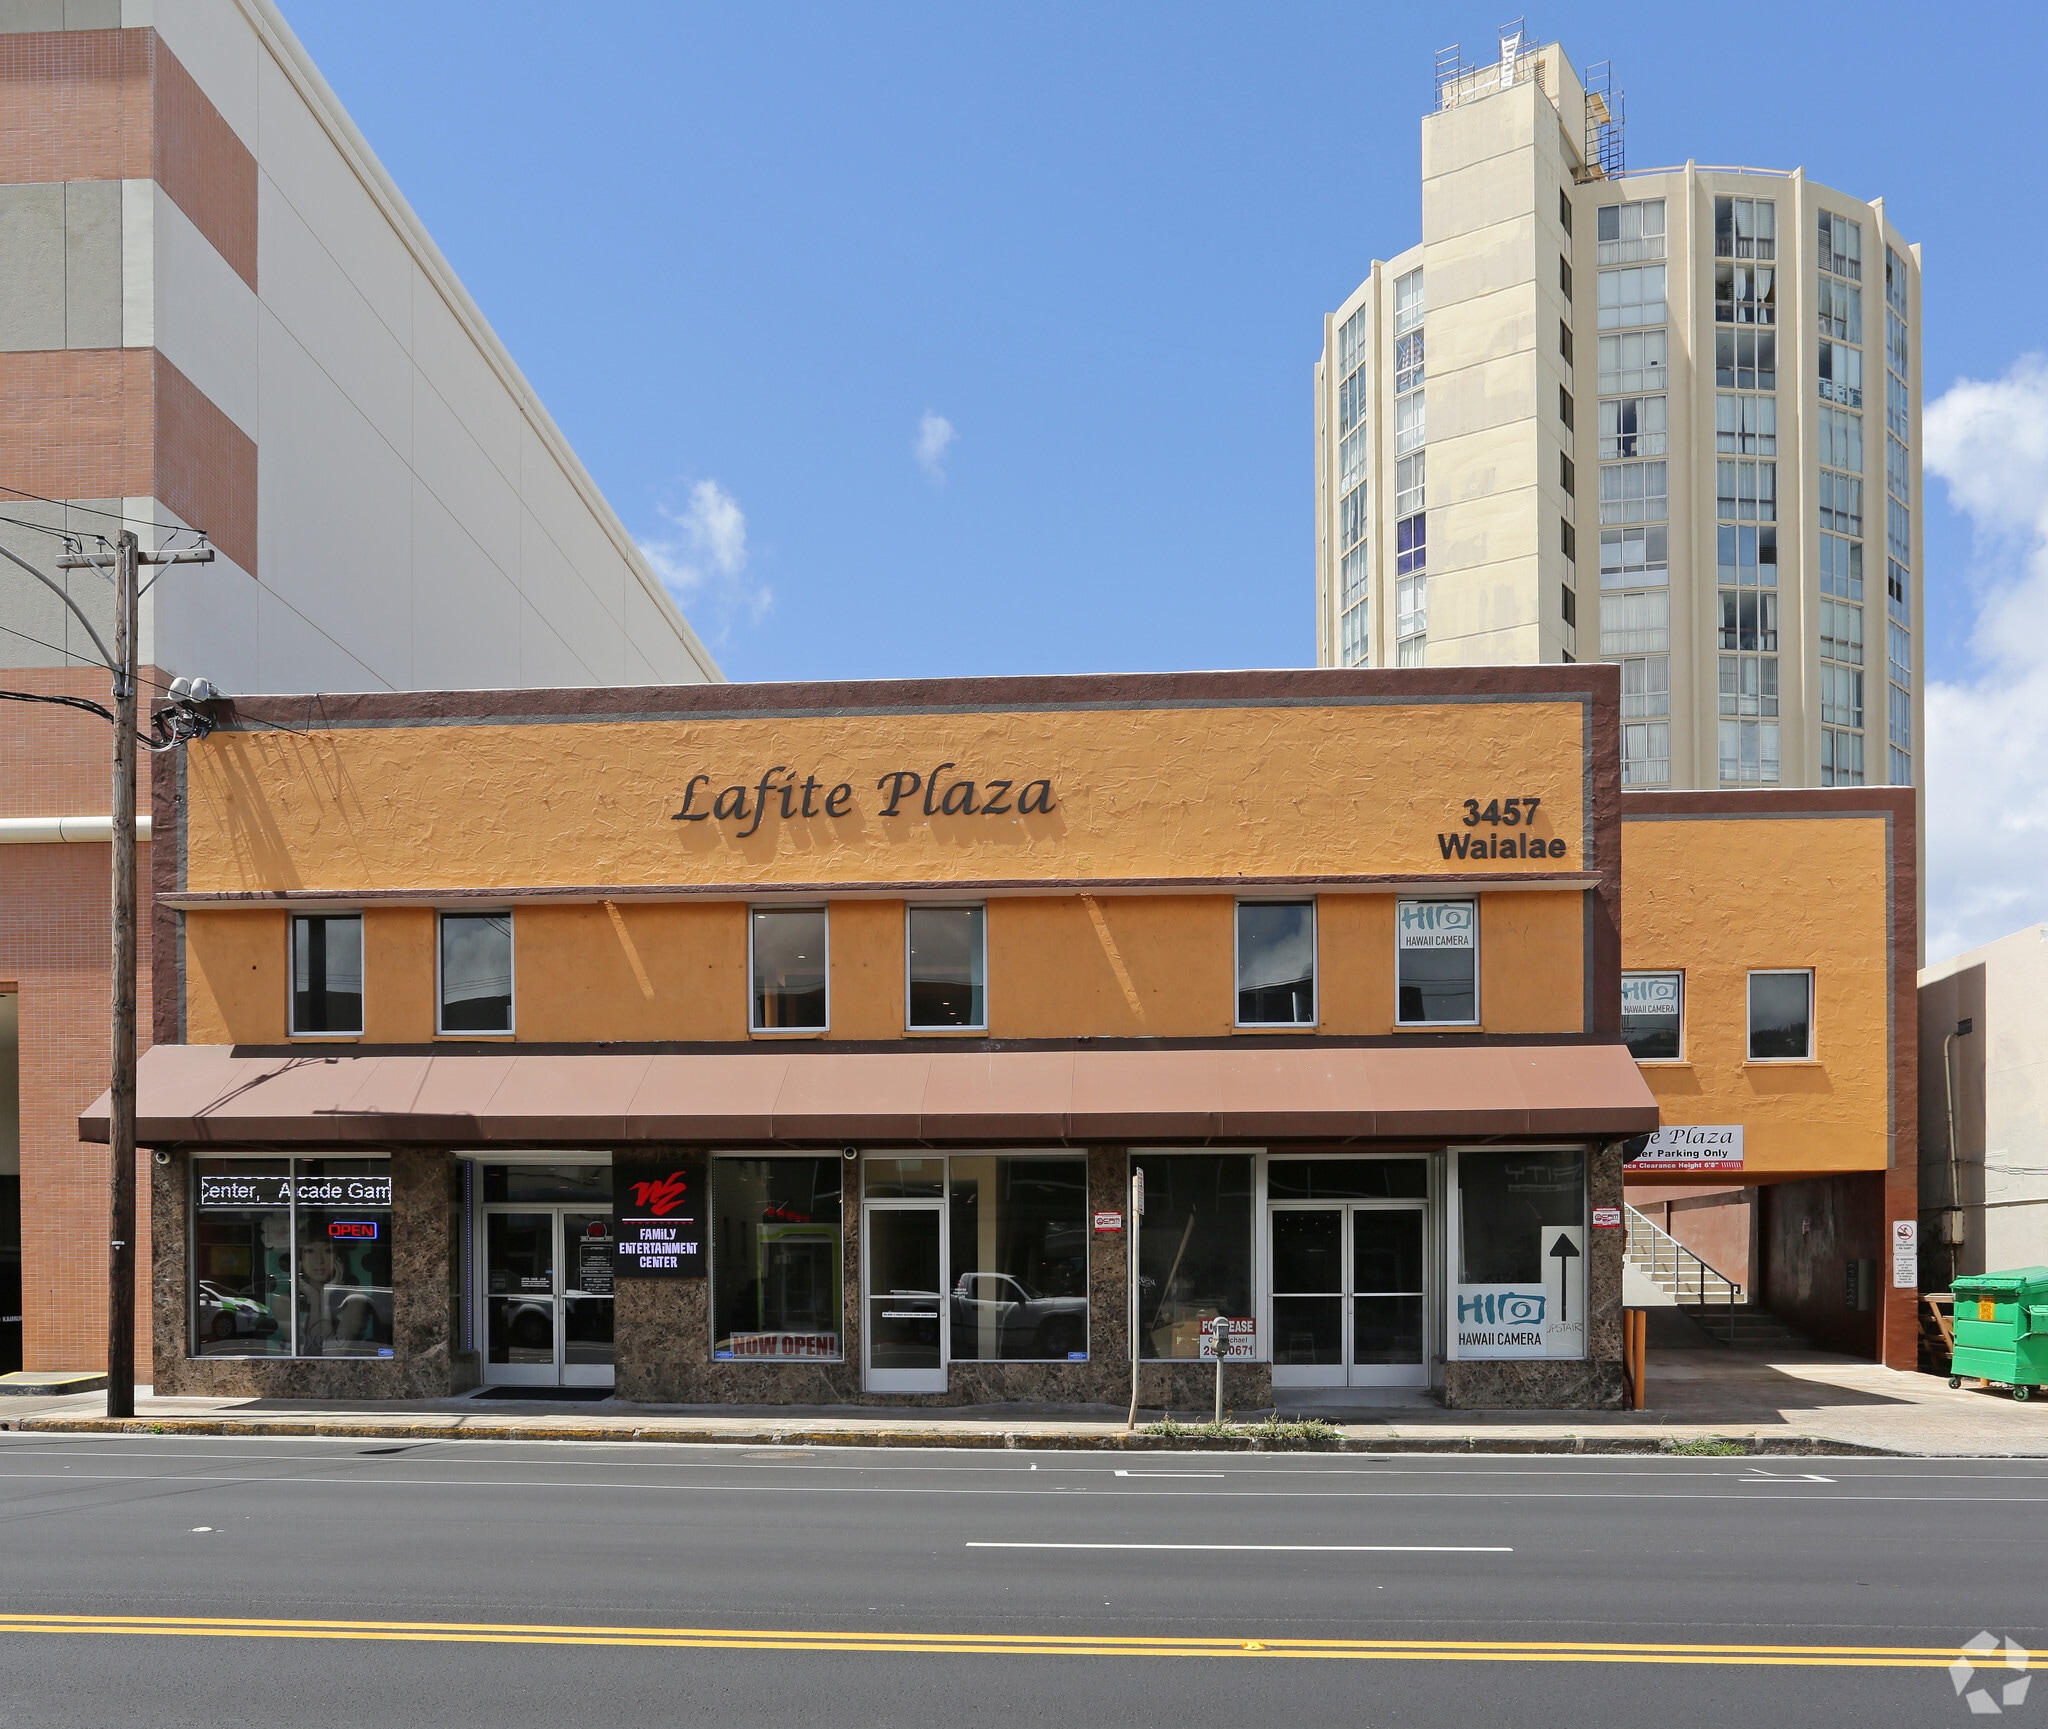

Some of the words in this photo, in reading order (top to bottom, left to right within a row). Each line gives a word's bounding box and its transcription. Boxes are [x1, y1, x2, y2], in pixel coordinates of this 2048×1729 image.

[671, 766, 852, 838] Lafite
[877, 763, 1057, 817] Plaza
[1462, 798, 1541, 827] 3457
[1437, 833, 1567, 860] Waialae
[1405, 936, 1434, 947] HAWAII
[1435, 935, 1469, 946] CAMERA
[1624, 1005, 1647, 1014] HAWAII
[1648, 1004, 1675, 1014] CAMERA
[1669, 1126, 1734, 1144] Plaza
[1657, 1149, 1700, 1159] Parking
[1703, 1149, 1728, 1158] Only
[1678, 1161, 1702, 1170] Height
[278, 1183, 342, 1199] Acade
[328, 1224, 374, 1237] OPEN
[639, 1256, 678, 1268] CENTER
[1229, 1320, 1253, 1332] EASE
[1458, 1333, 1495, 1345] HAWAII
[1497, 1332, 1542, 1345] CAMERA
[733, 1337, 777, 1355] NOW
[781, 1336, 835, 1355] OPEN!
